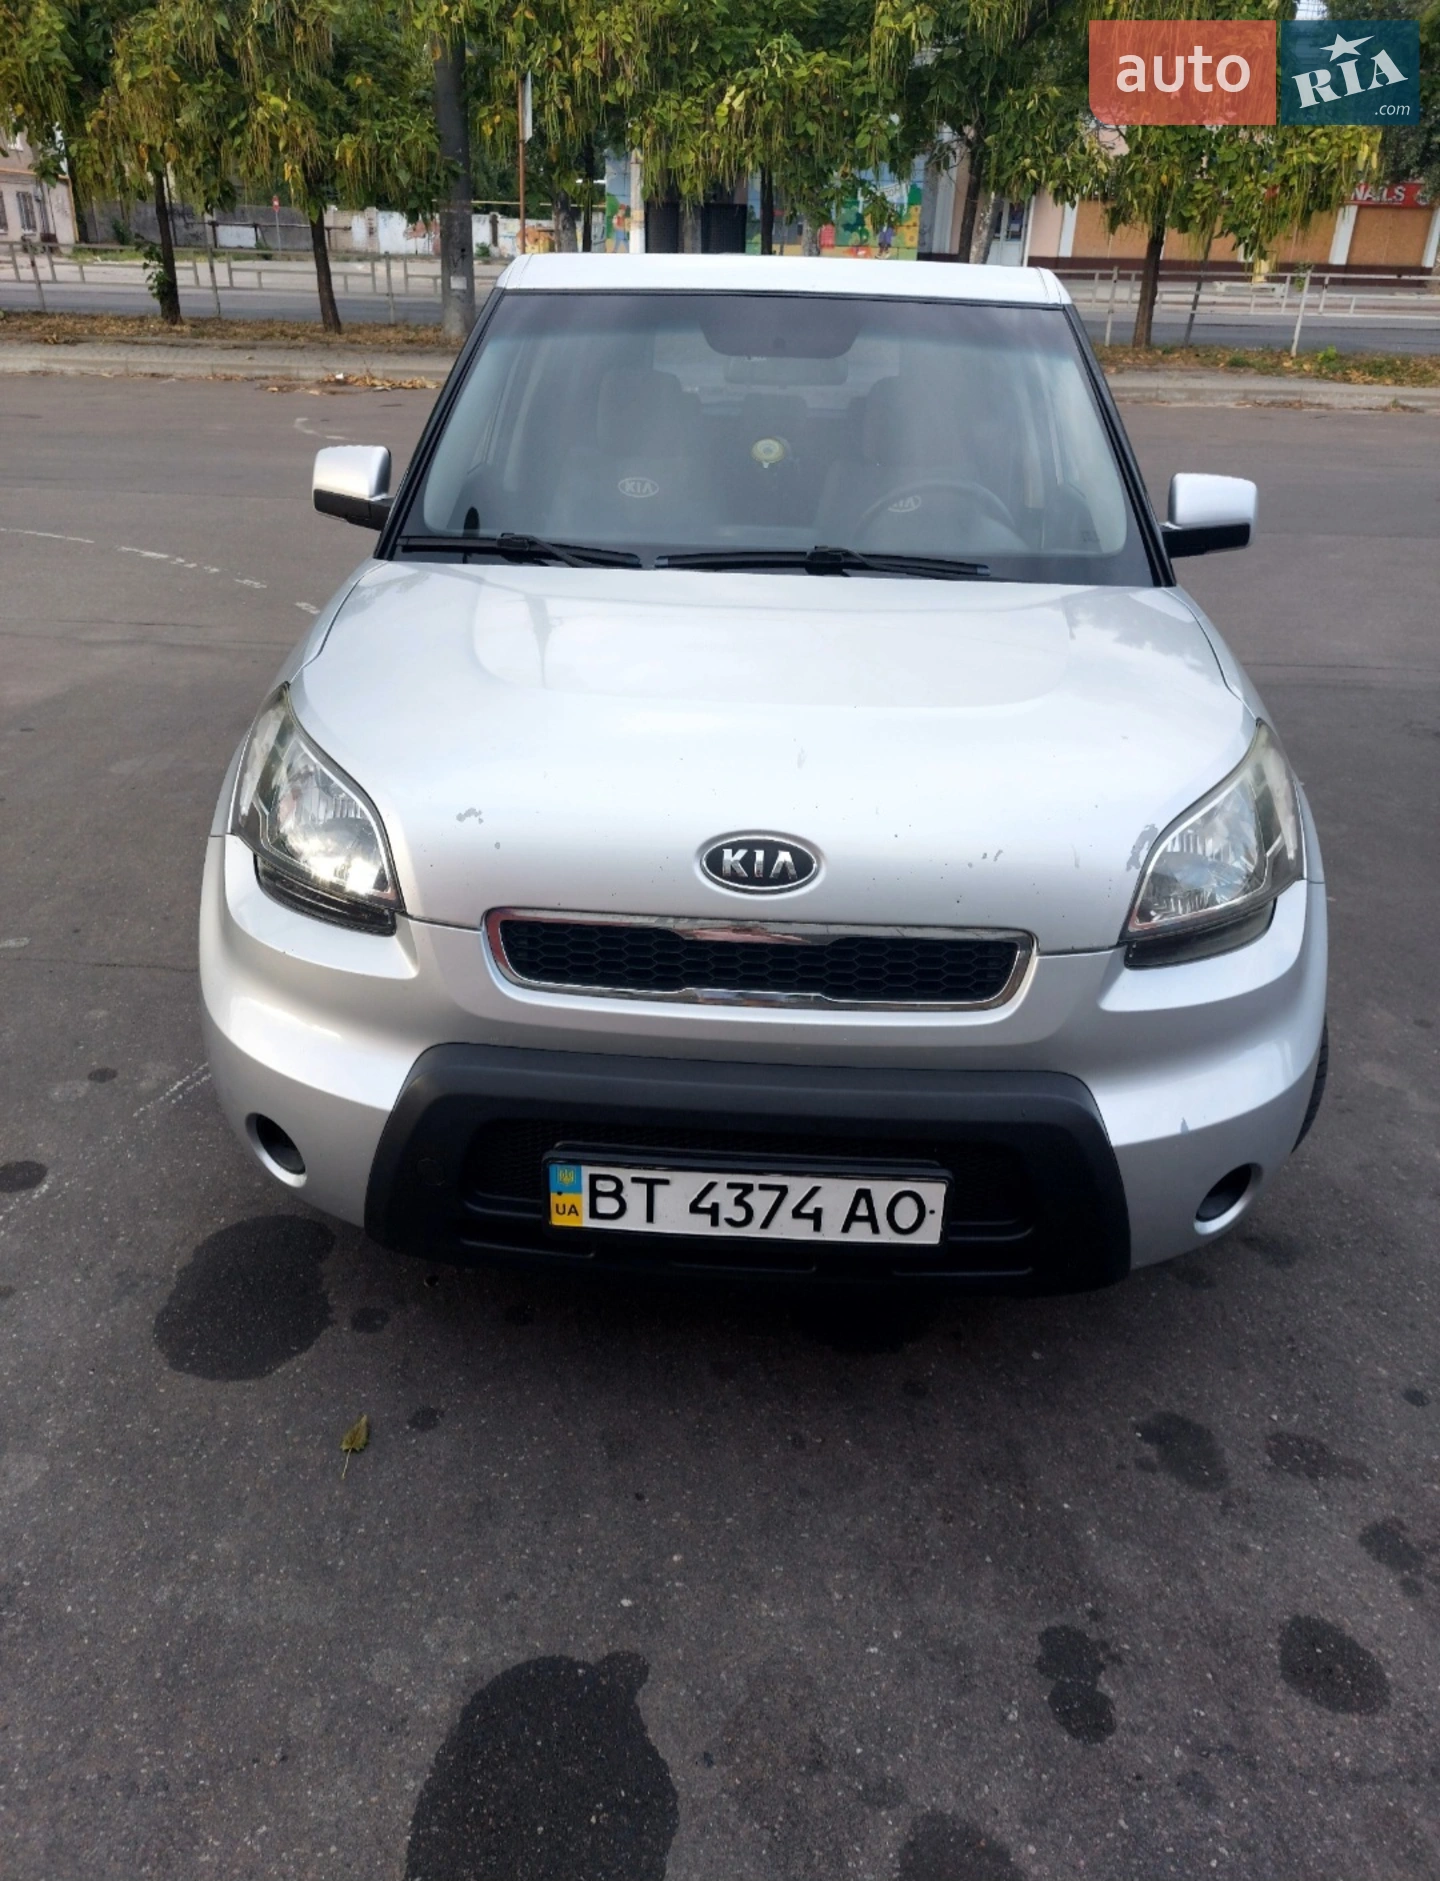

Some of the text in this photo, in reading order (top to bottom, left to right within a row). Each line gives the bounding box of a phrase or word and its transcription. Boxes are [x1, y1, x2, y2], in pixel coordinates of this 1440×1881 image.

[624, 480, 653, 494] KIA
[721, 848, 798, 880] KIA
[555, 1203, 579, 1217] UA
[587, 1172, 927, 1236] BT 4374 AO
